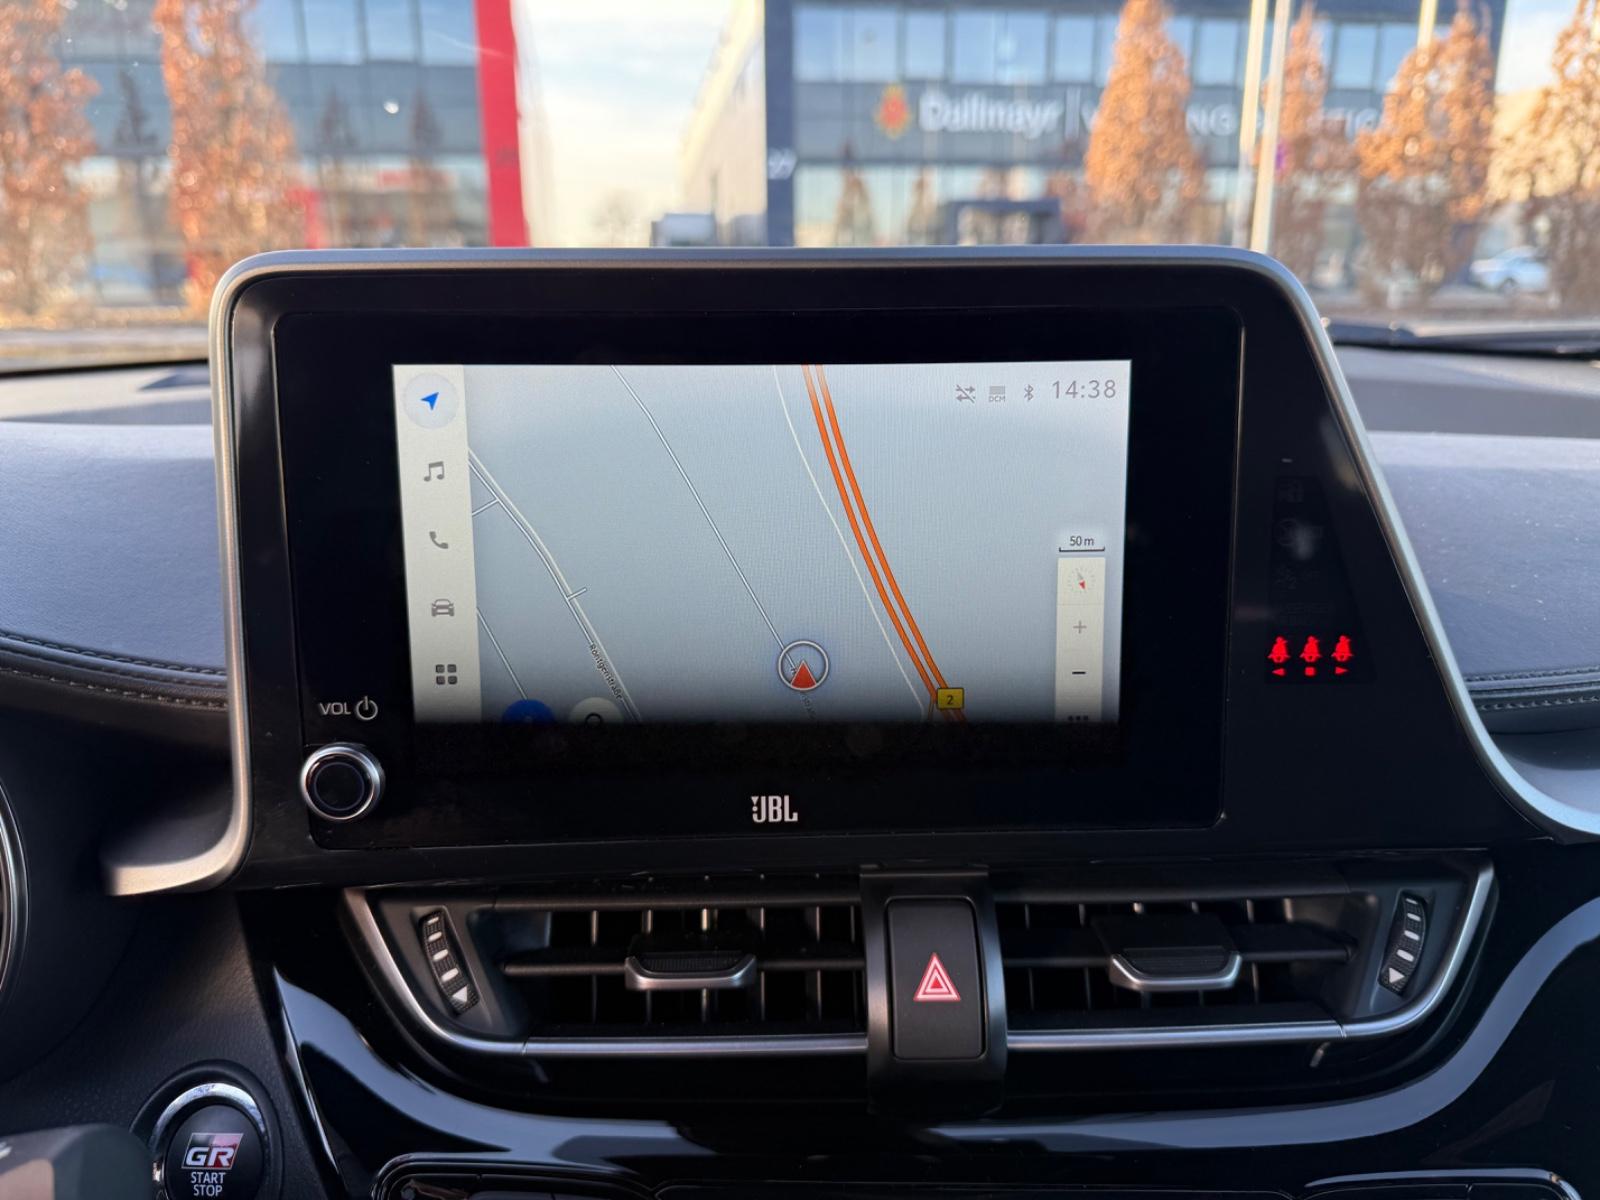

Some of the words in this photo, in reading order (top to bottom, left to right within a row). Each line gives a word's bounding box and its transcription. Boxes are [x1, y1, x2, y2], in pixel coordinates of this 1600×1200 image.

[919, 92, 1062, 138] Dallmayr
[1052, 379, 1117, 399] 14:38
[988, 395, 1006, 403] DCM
[1069, 535, 1082, 547] 50
[1083, 538, 1095, 547] m
[946, 694, 955, 706] 2
[319, 702, 352, 716] VOL
[751, 794, 799, 823] JBL
[185, 1146, 235, 1167] GR
[190, 1171, 226, 1185] START
[193, 1184, 223, 1197] STOP
